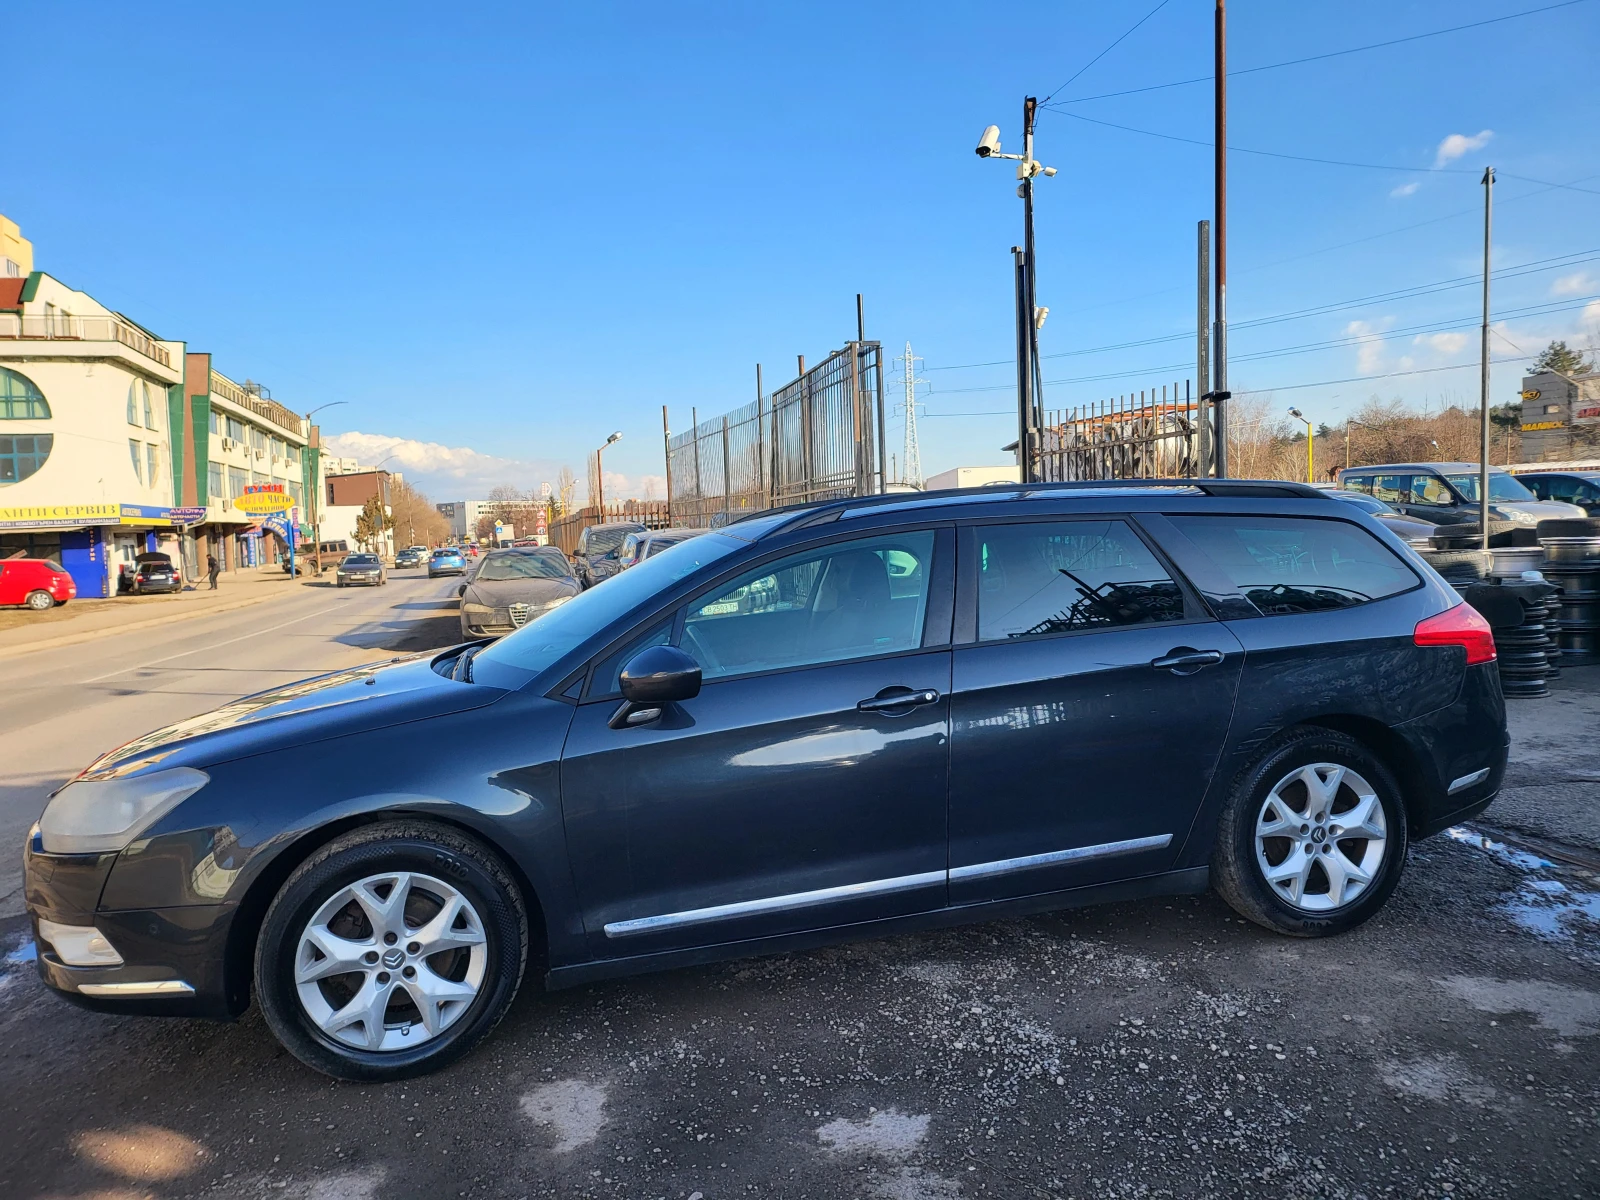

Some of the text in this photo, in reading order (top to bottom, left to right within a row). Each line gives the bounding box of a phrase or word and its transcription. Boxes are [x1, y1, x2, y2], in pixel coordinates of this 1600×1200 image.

[243, 484, 283, 495] ГУМИ
[239, 494, 291, 505] АВТО ЧАСТИ
[53, 505, 116, 516] СЕРВИЗ
